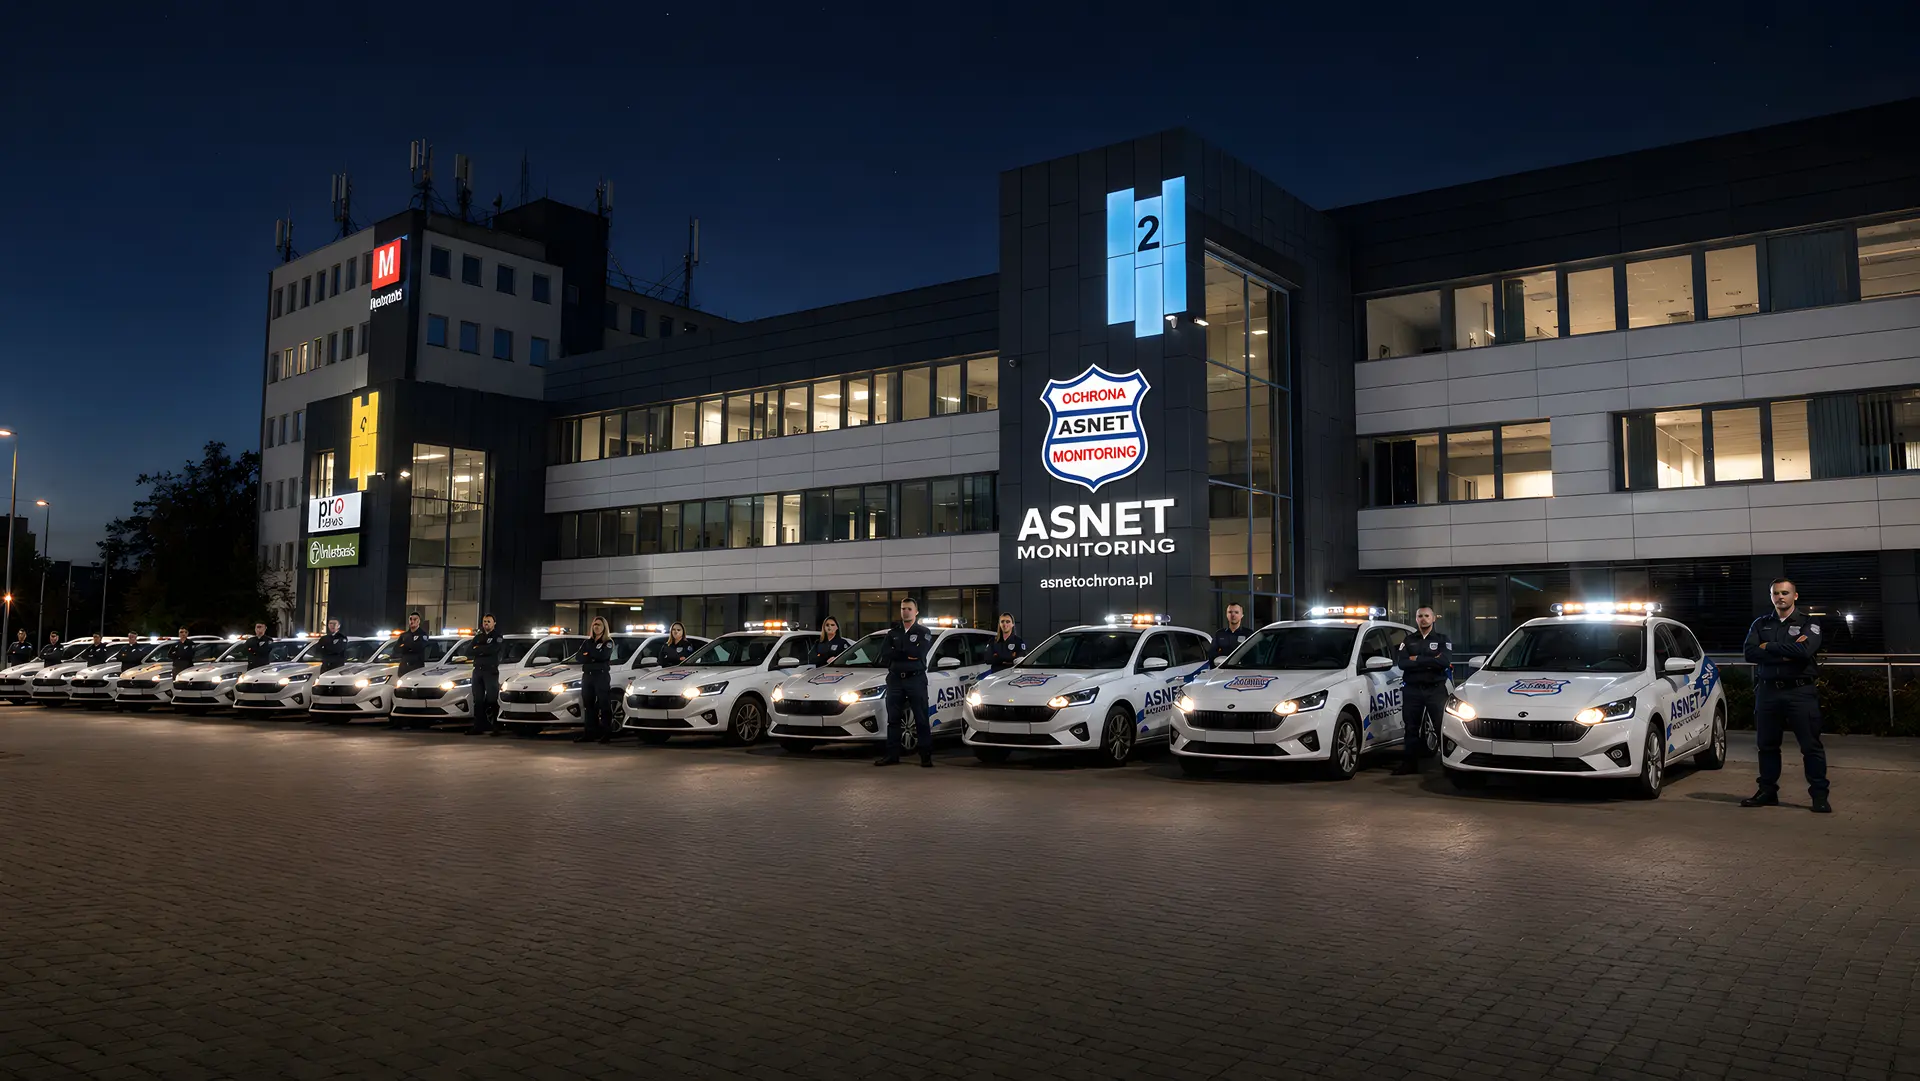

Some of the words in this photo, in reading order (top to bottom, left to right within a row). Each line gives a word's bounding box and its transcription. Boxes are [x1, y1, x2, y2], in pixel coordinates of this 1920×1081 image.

[1138, 215, 1160, 252] 2
[378, 246, 395, 279] M
[1062, 387, 1126, 404] OCHRONA
[1058, 414, 1129, 435] ASNET
[1053, 445, 1137, 463] MONITORING
[1017, 498, 1175, 541] ASNET
[1017, 538, 1175, 560] MONITORING
[1040, 572, 1153, 589] asnetochrona.pl
[1671, 691, 1700, 721] ASNET
